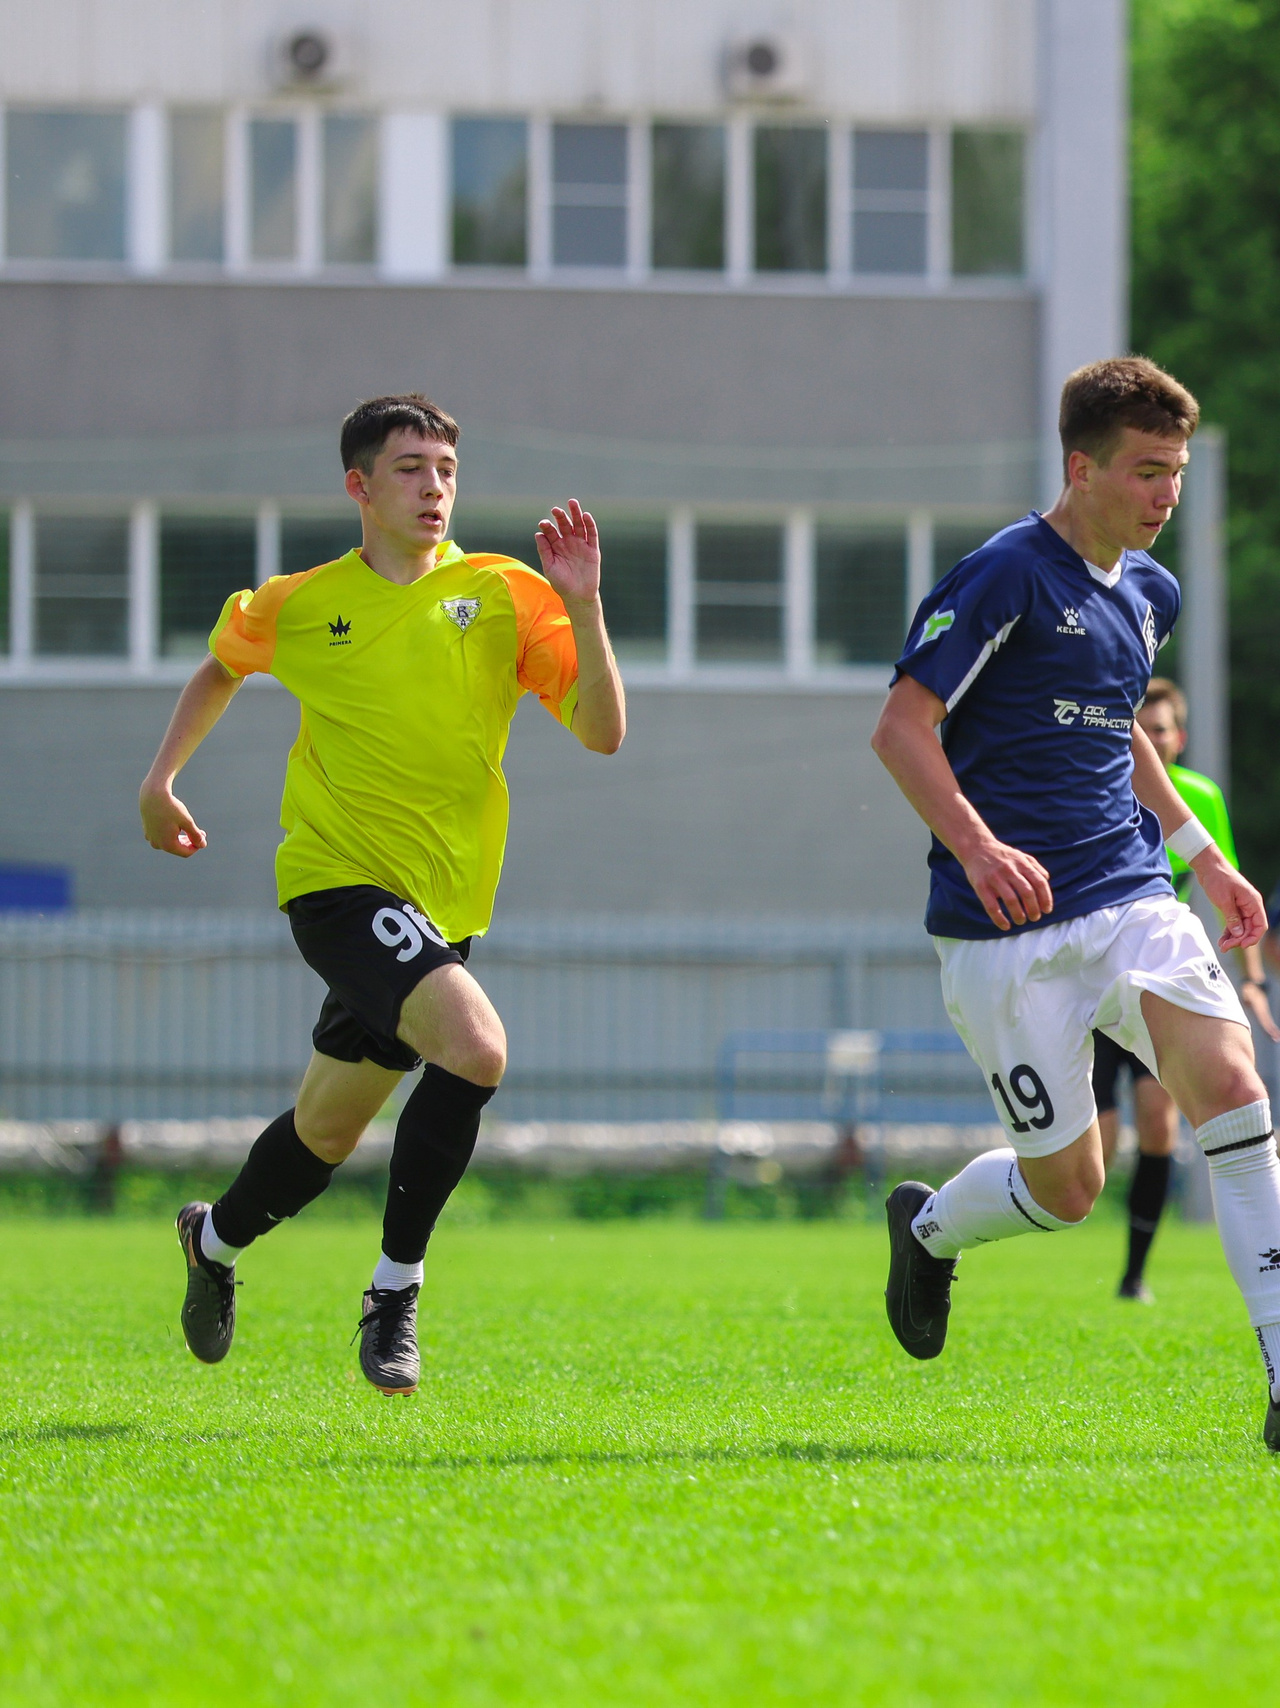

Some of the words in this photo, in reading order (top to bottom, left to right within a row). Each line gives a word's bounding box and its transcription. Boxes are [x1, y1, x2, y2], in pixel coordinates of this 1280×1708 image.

[1056, 625, 1086, 636] KELME
[1083, 705, 1107, 717] ДСК
[991, 1064, 1055, 1133] 19
